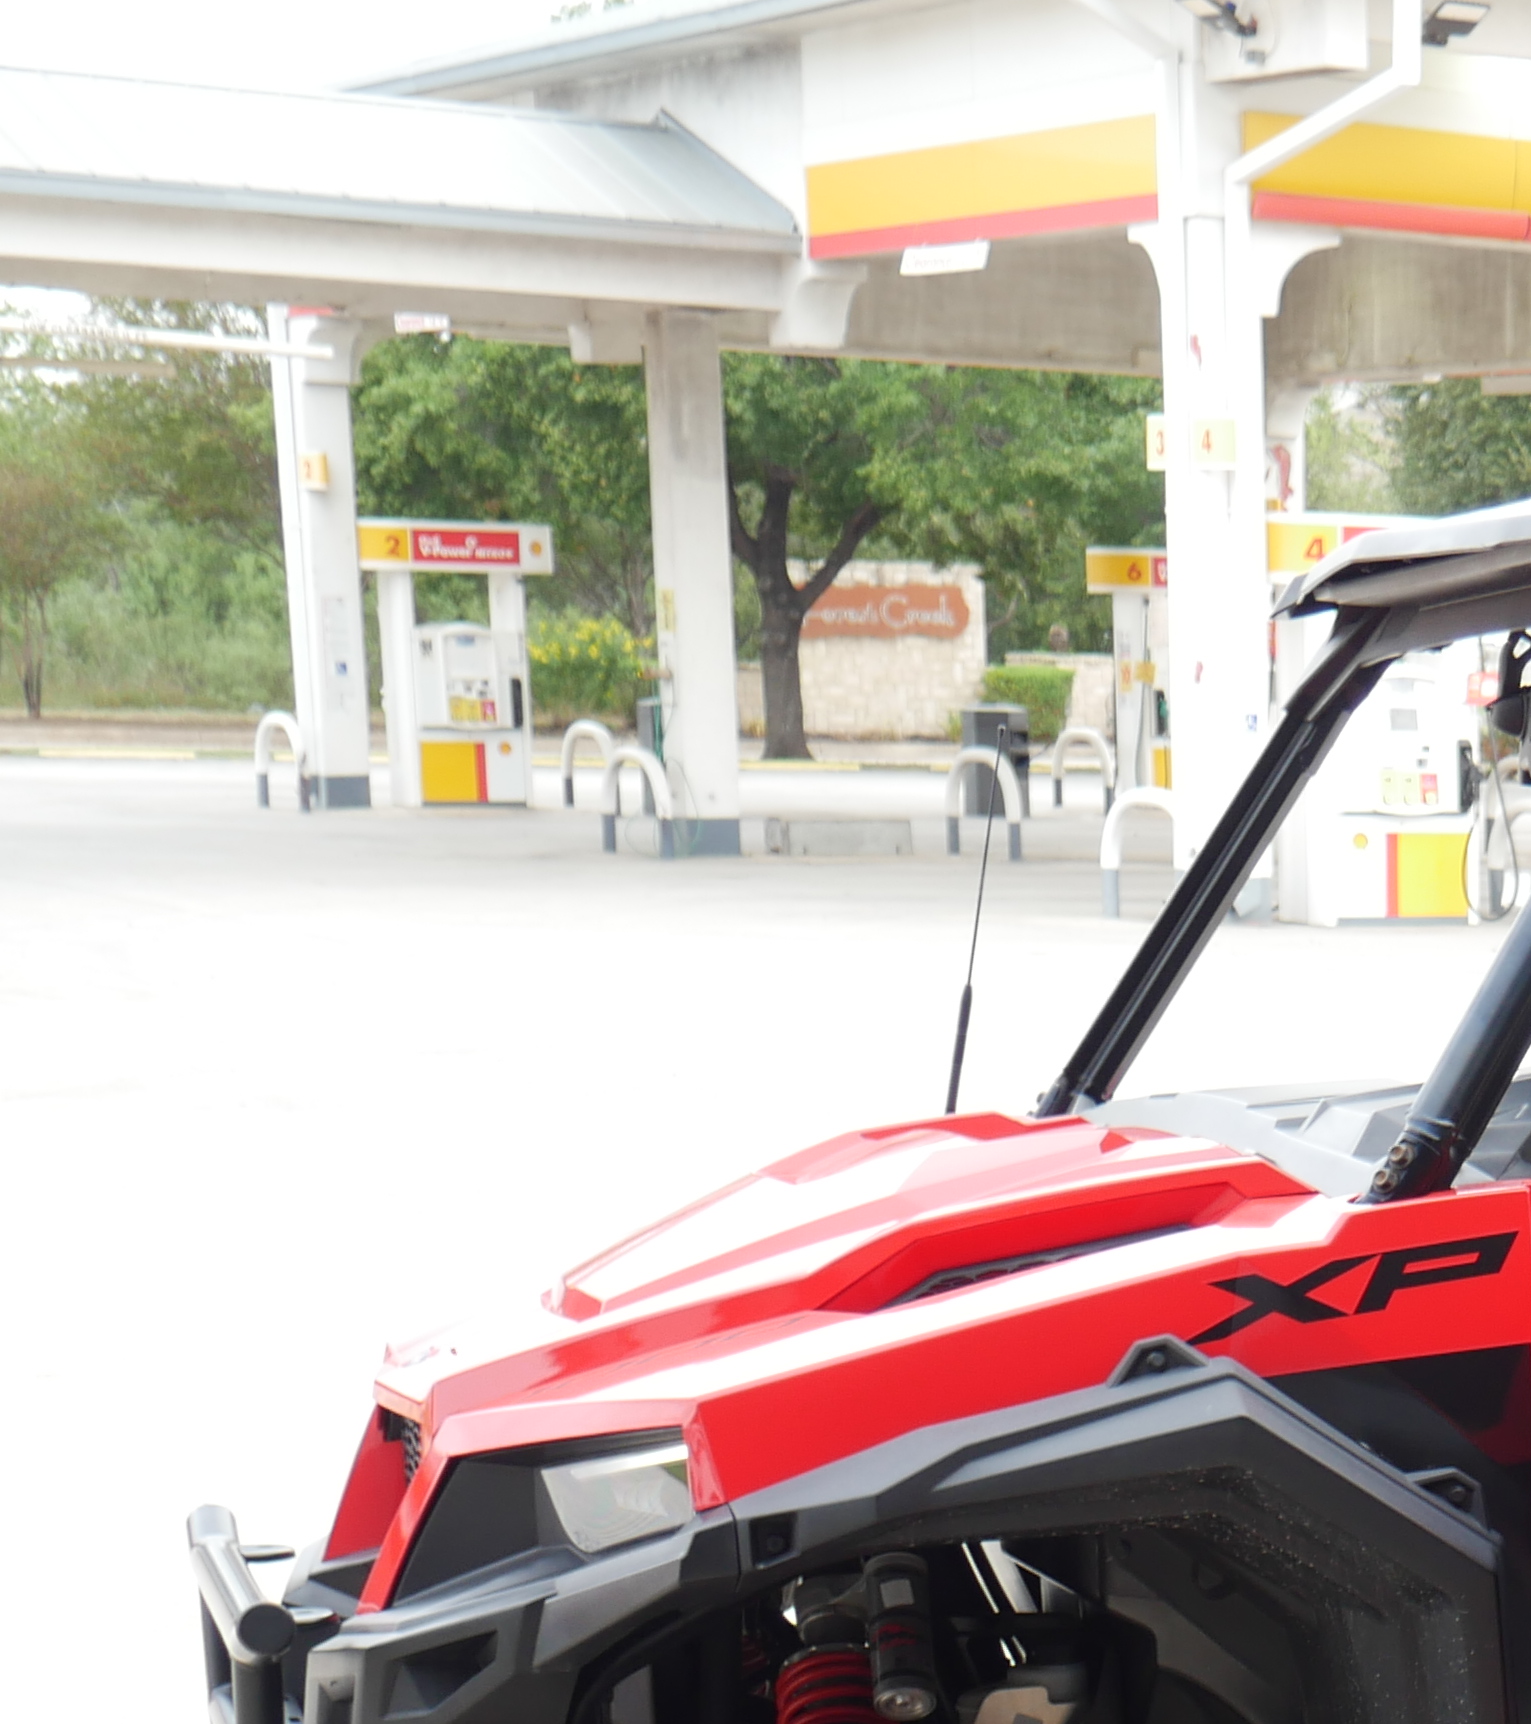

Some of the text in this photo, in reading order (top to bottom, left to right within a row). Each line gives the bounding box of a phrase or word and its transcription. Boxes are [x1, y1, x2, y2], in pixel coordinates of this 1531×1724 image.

[1202, 429, 1212, 453] 4
[385, 535, 401, 556] 2
[1304, 538, 1325, 562] 4
[1127, 562, 1143, 582] 6
[1186, 1231, 1519, 1344] XP
